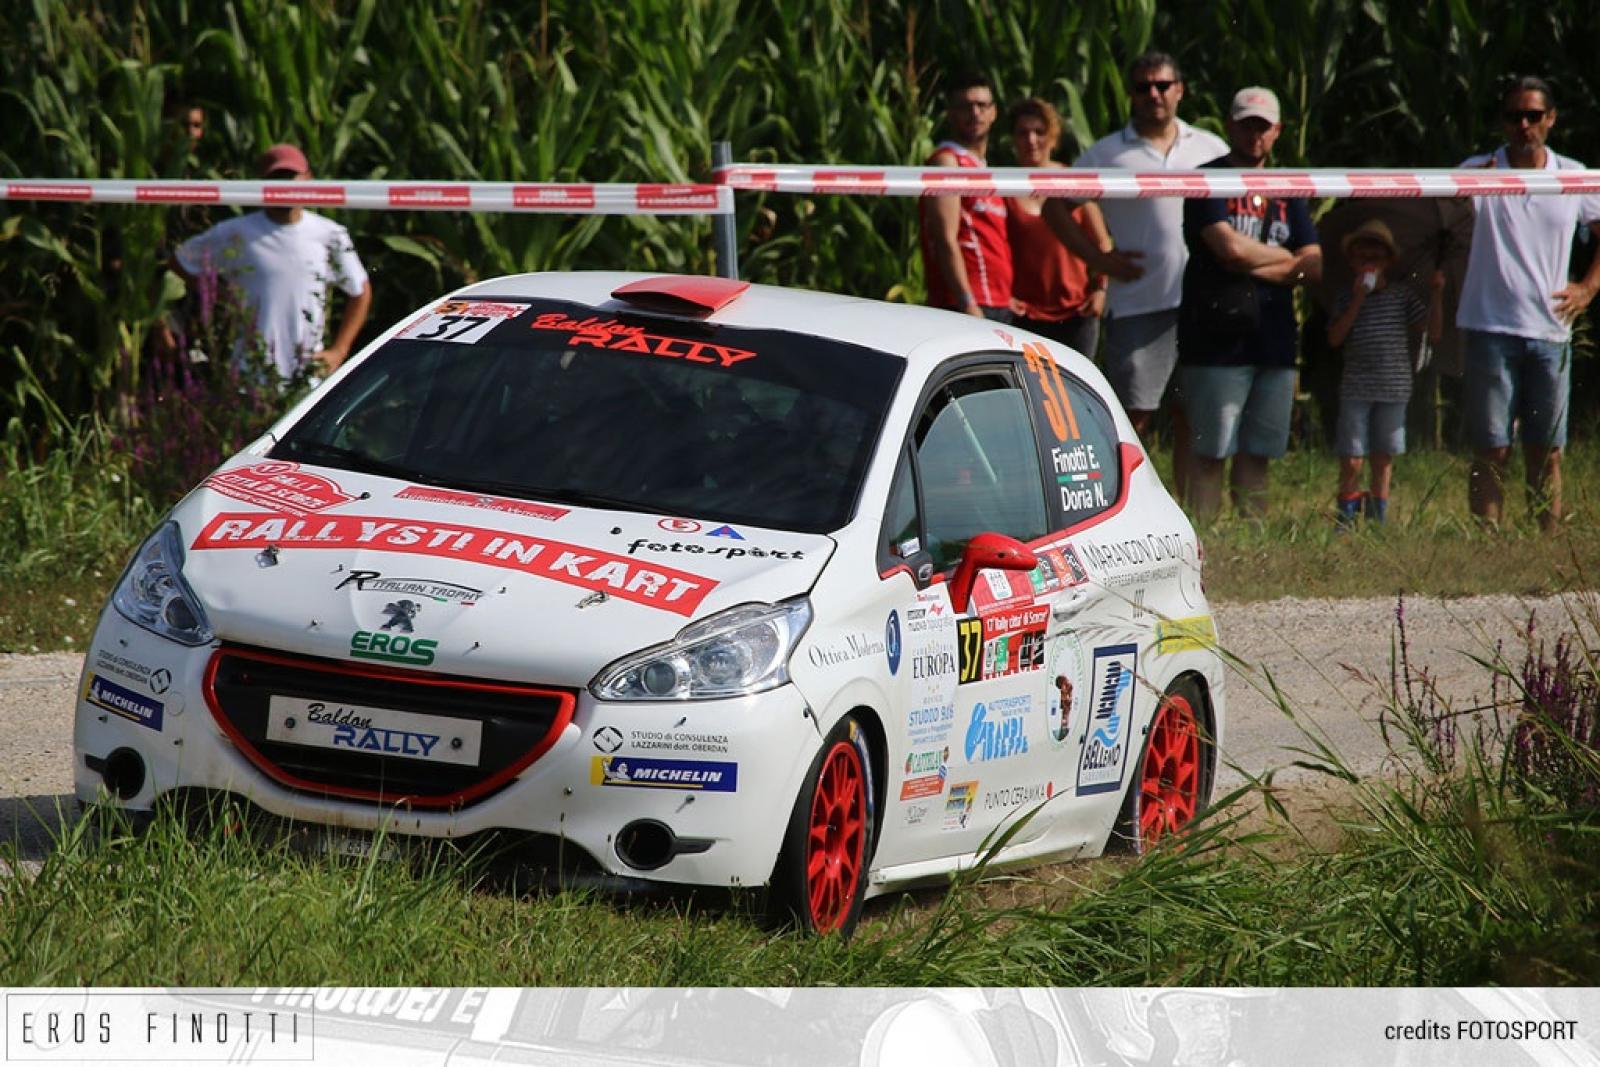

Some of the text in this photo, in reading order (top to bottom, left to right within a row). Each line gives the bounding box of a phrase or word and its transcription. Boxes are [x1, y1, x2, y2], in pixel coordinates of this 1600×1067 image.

[416, 315, 491, 340] 37
[568, 331, 757, 366] RALLY
[1022, 341, 1081, 442] 37
[1052, 444, 1100, 473] Finotti E.
[1060, 481, 1109, 511] Doria N.
[628, 538, 806, 560] fotosport
[482, 535, 546, 566] IN
[549, 549, 700, 602] KART
[372, 579, 427, 593] ITALIAN
[430, 586, 483, 601] TROPHY
[350, 630, 439, 667] EROS
[960, 619, 982, 682] 37
[912, 652, 955, 679] EUROPA
[101, 689, 154, 719] MICHELIN
[307, 702, 373, 729] Baldon
[333, 725, 442, 757] RALLY
[631, 730, 663, 740] STUDIO
[674, 733, 729, 744] CONSULENZA
[633, 767, 723, 782] MICHELIN
